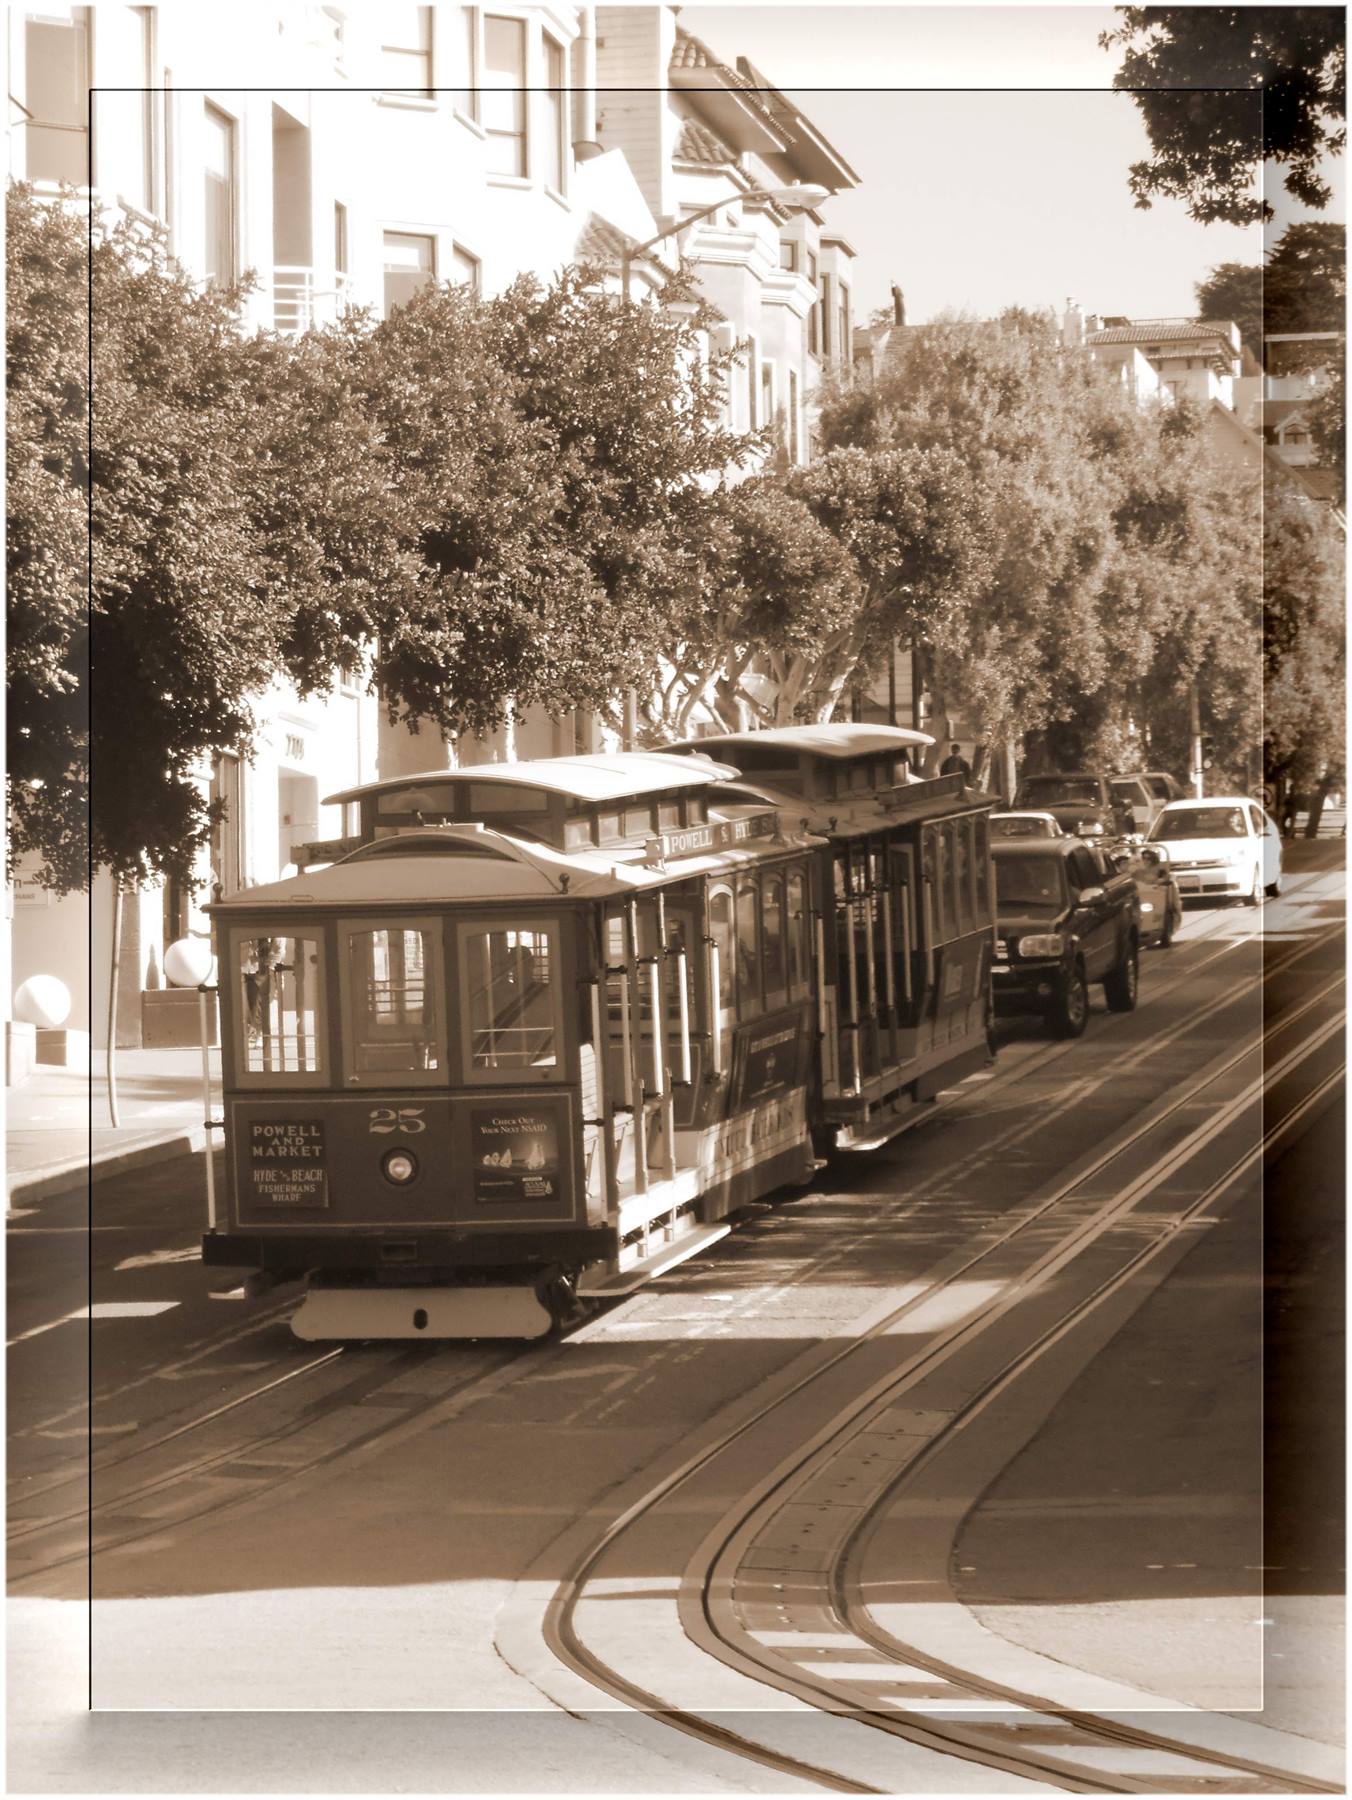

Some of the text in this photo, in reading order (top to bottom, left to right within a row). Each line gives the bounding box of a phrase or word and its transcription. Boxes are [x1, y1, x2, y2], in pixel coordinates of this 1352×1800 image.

[671, 830, 712, 852] POWELL
[369, 1108, 426, 1134] 25
[253, 1126, 321, 1136] POWELL
[271, 1136, 305, 1146] AND
[252, 1146, 323, 1156] MARKET
[253, 1169, 277, 1182] HYDE
[291, 1168, 323, 1182] BEACH
[258, 1184, 316, 1193] FISHERMANS
